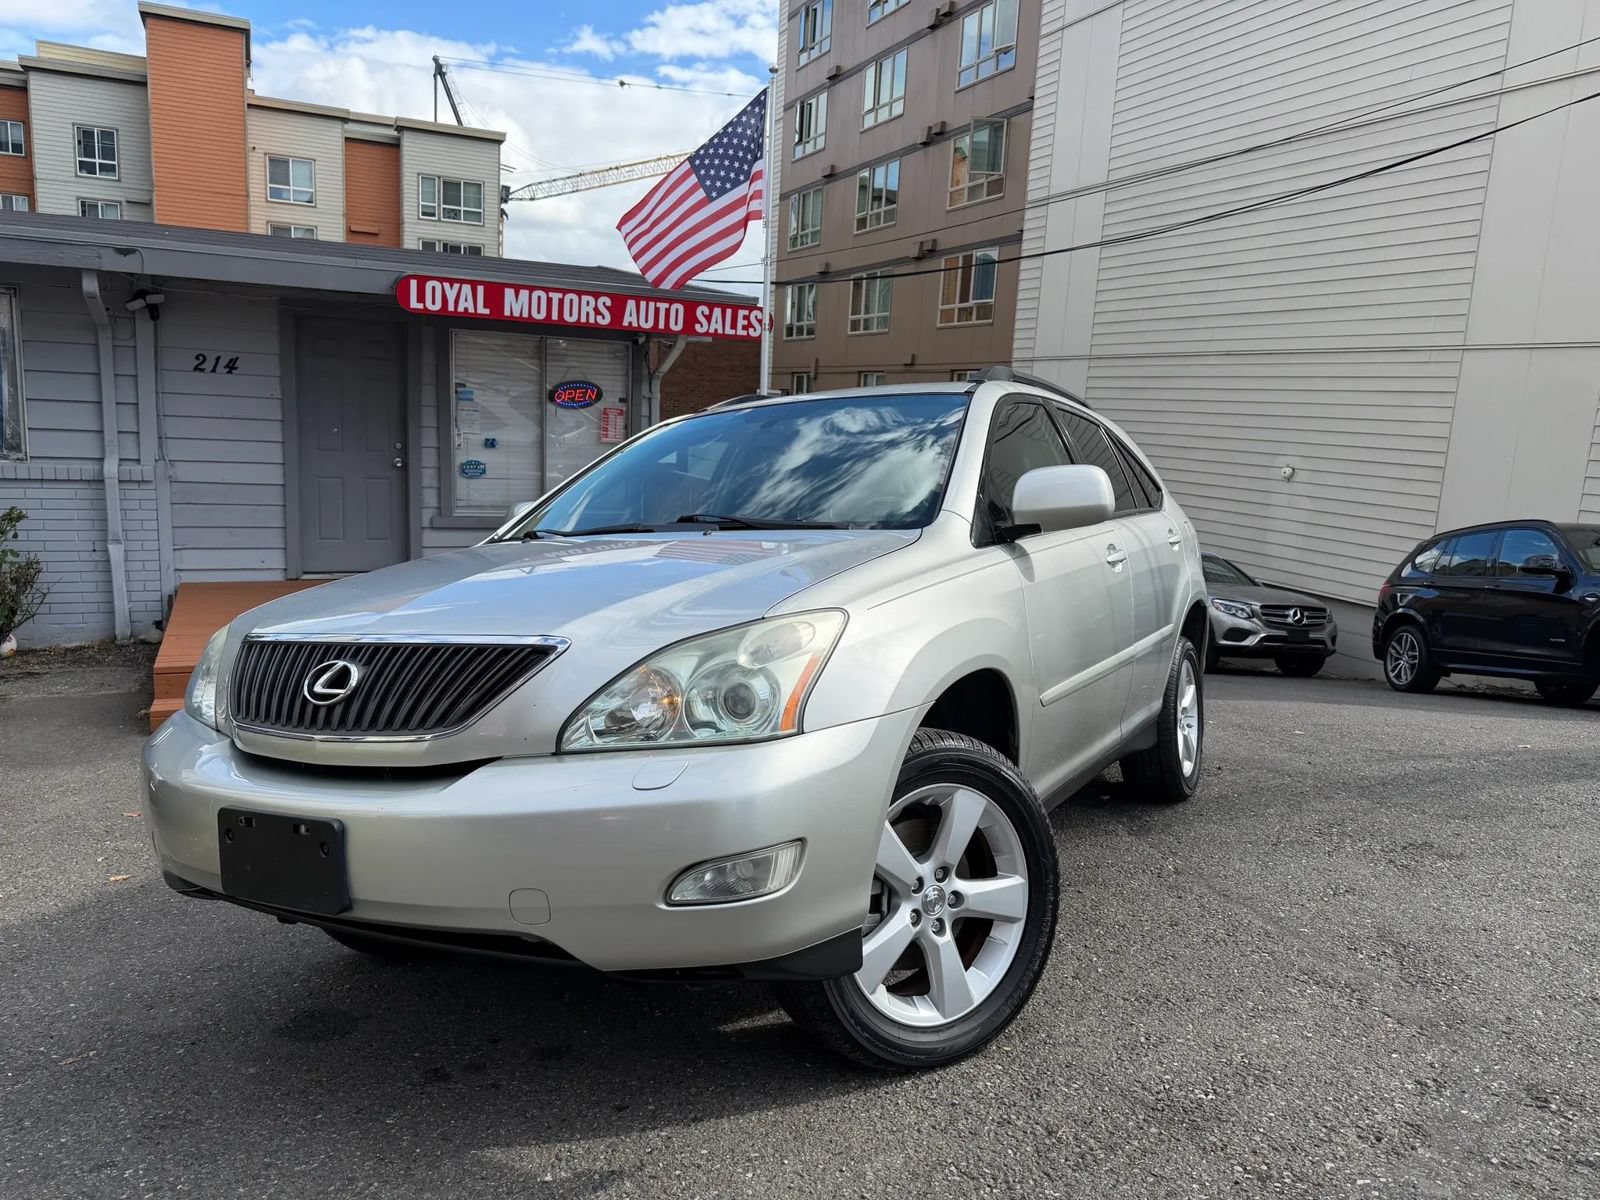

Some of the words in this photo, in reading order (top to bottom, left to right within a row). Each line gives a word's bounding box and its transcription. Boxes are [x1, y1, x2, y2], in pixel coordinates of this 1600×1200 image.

[409, 279, 490, 315] LOYAL
[503, 287, 612, 325] MOTORS
[622, 299, 684, 332] AUTO
[694, 305, 763, 338] SALES
[193, 353, 240, 374] 214
[554, 389, 598, 402] OPEN
